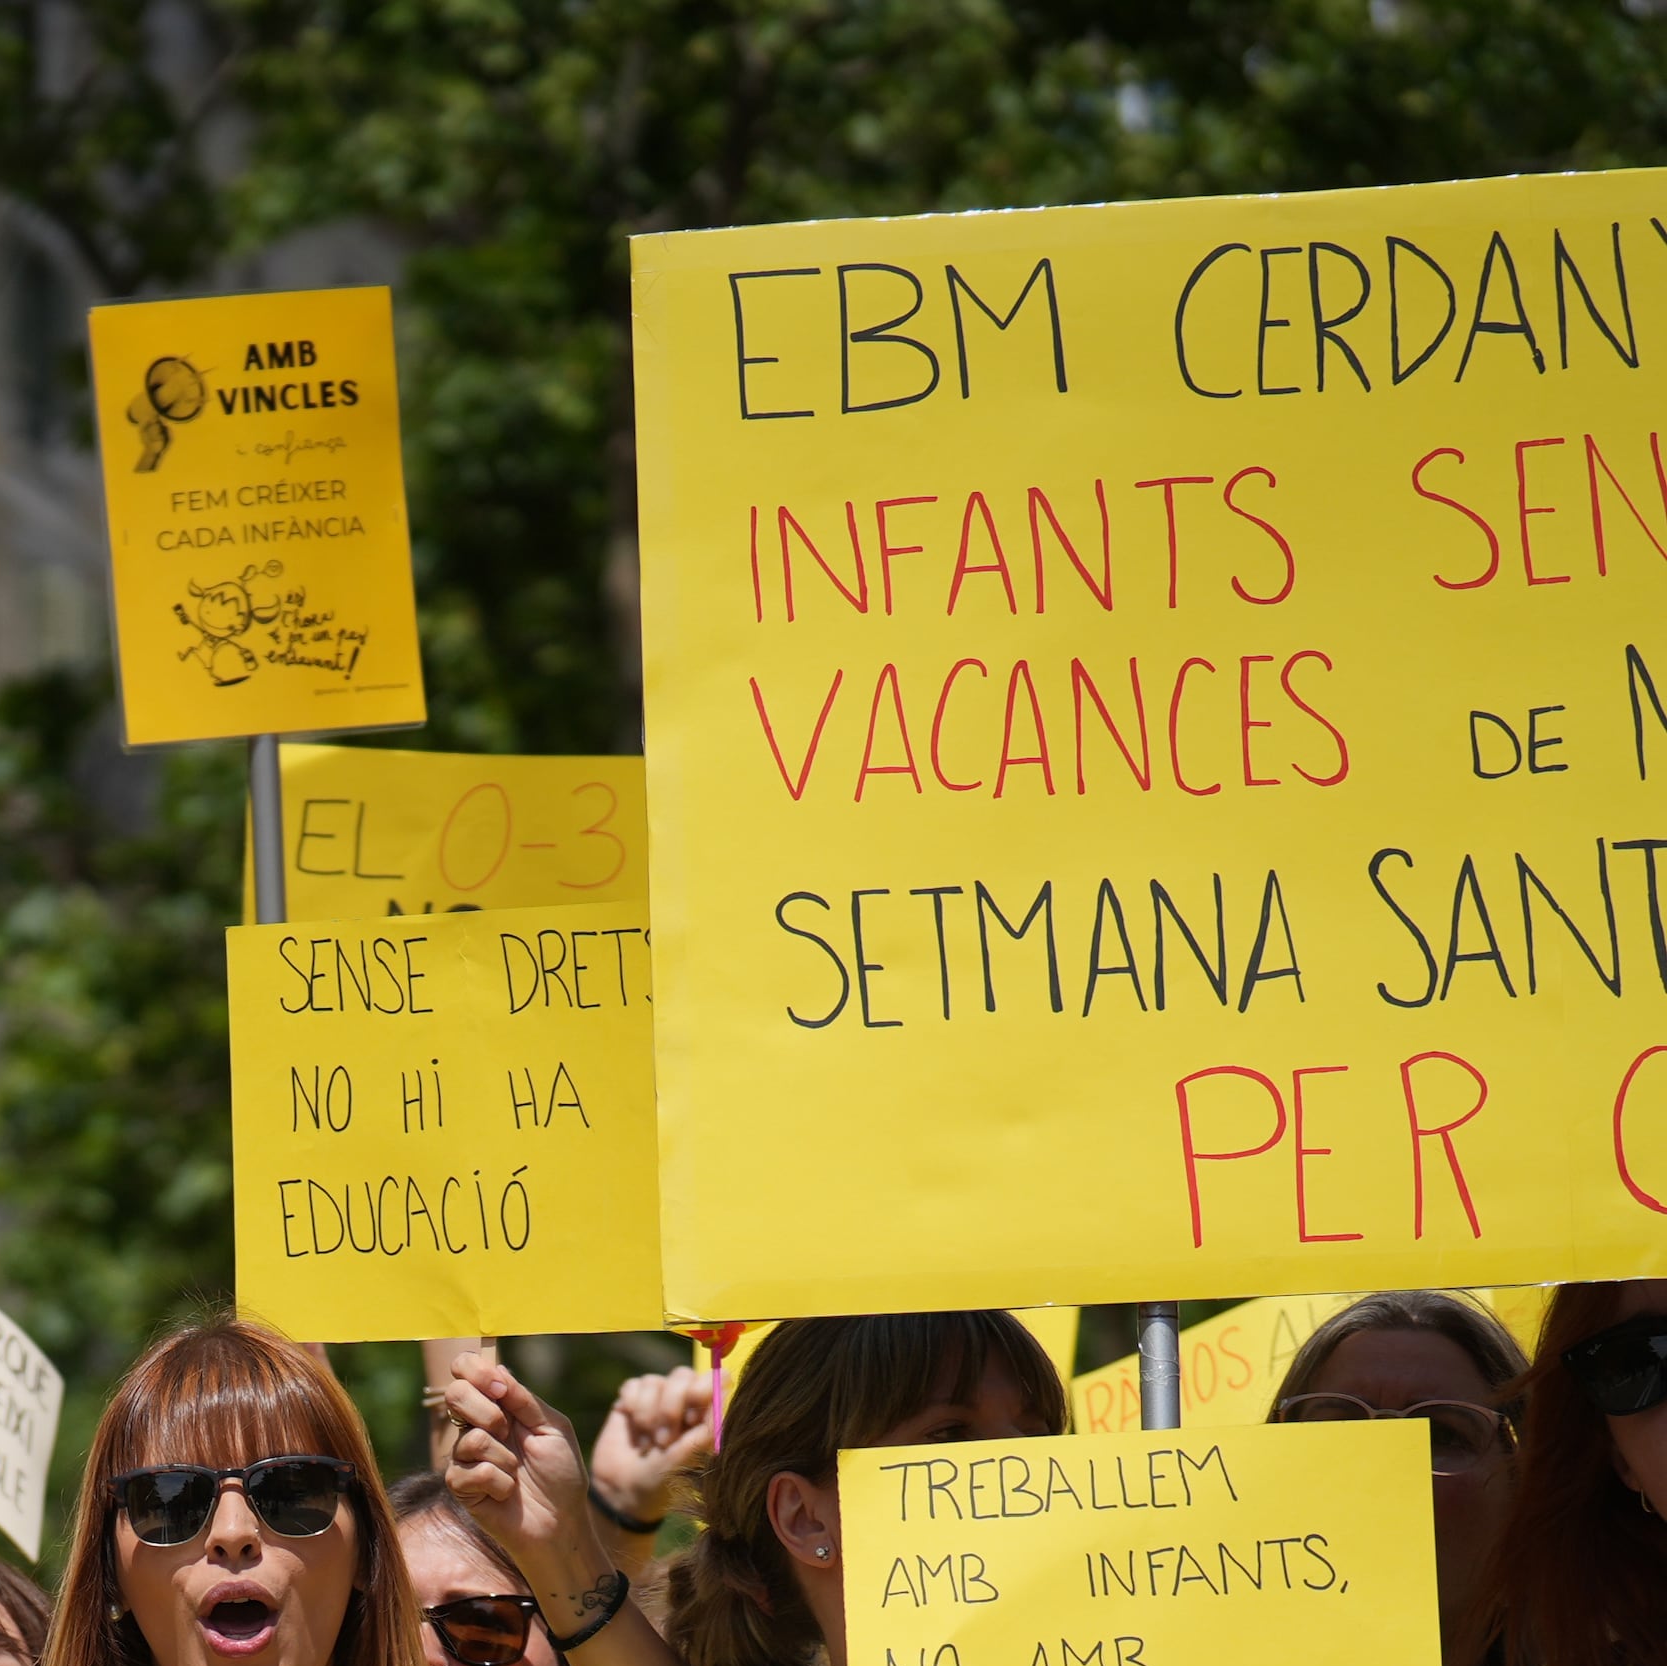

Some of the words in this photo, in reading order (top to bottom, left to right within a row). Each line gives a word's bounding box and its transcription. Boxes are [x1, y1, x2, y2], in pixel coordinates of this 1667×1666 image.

[244, 340, 317, 372] AMB
[727, 256, 1069, 421] EBM
[1174, 218, 1667, 400] CERDAN
[217, 379, 360, 416] VINCLES
[156, 524, 236, 552] CADA
[243, 514, 366, 546] INFÀNCIA
[171, 490, 229, 513] FEM
[237, 478, 347, 508] CRÉIXER
[749, 465, 1296, 624] INFANTS
[749, 648, 1350, 803] VACANCES
[1468, 704, 1569, 780] DE
[295, 797, 405, 880] EL
[438, 782, 626, 892] 0-3
[278, 935, 434, 1015] SENSE
[499, 928, 652, 1014] DRET
[775, 868, 1306, 1028] SETMANA
[290, 1064, 353, 1133] NO
[507, 1061, 591, 1131] HA
[1175, 1050, 1489, 1248] PER
[879, 1445, 1238, 1522] TREBALLEM
[881, 1552, 999, 1609] AMB
[1086, 1534, 1350, 1600] INFANTS,
